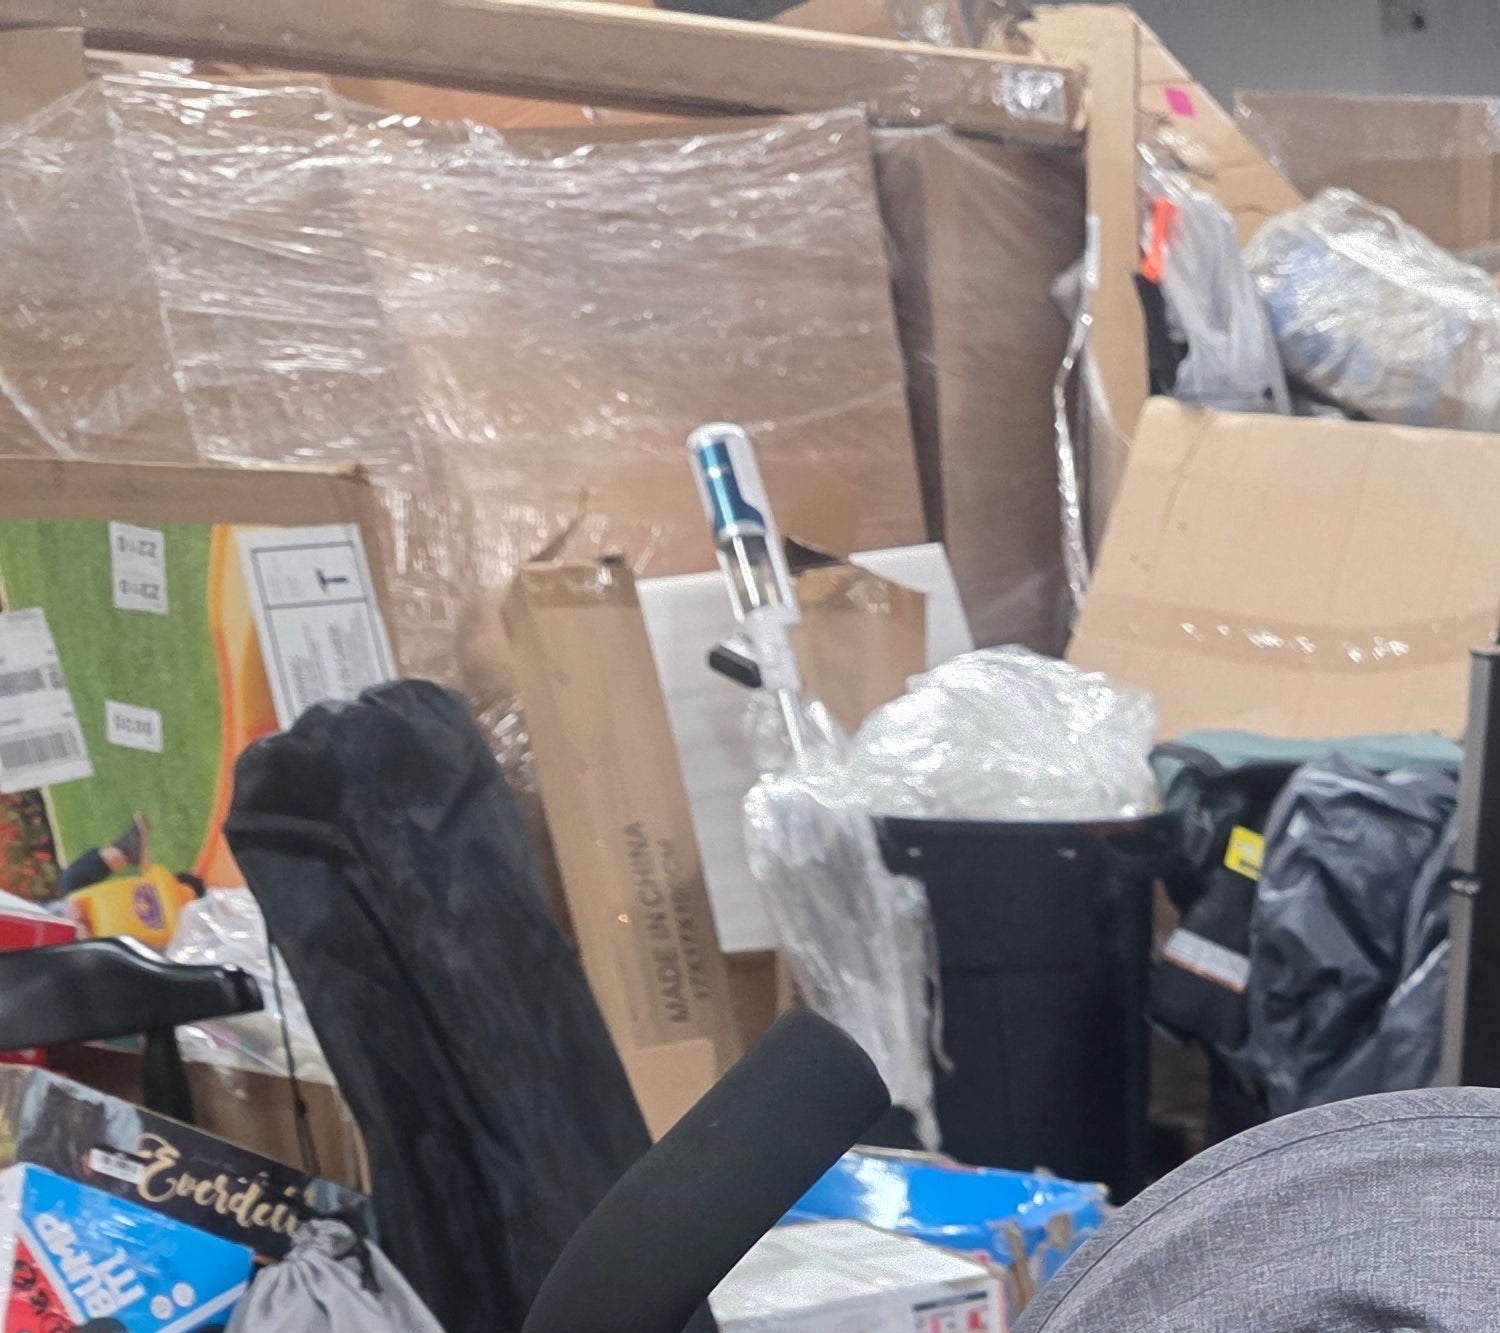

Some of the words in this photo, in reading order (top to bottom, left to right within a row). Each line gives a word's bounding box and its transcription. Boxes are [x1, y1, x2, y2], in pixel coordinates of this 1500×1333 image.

[623, 821, 664, 907] CHINA
[647, 912, 672, 941] IN
[653, 947, 690, 1022] MADE
[34, 1213, 114, 1319] BUMP
